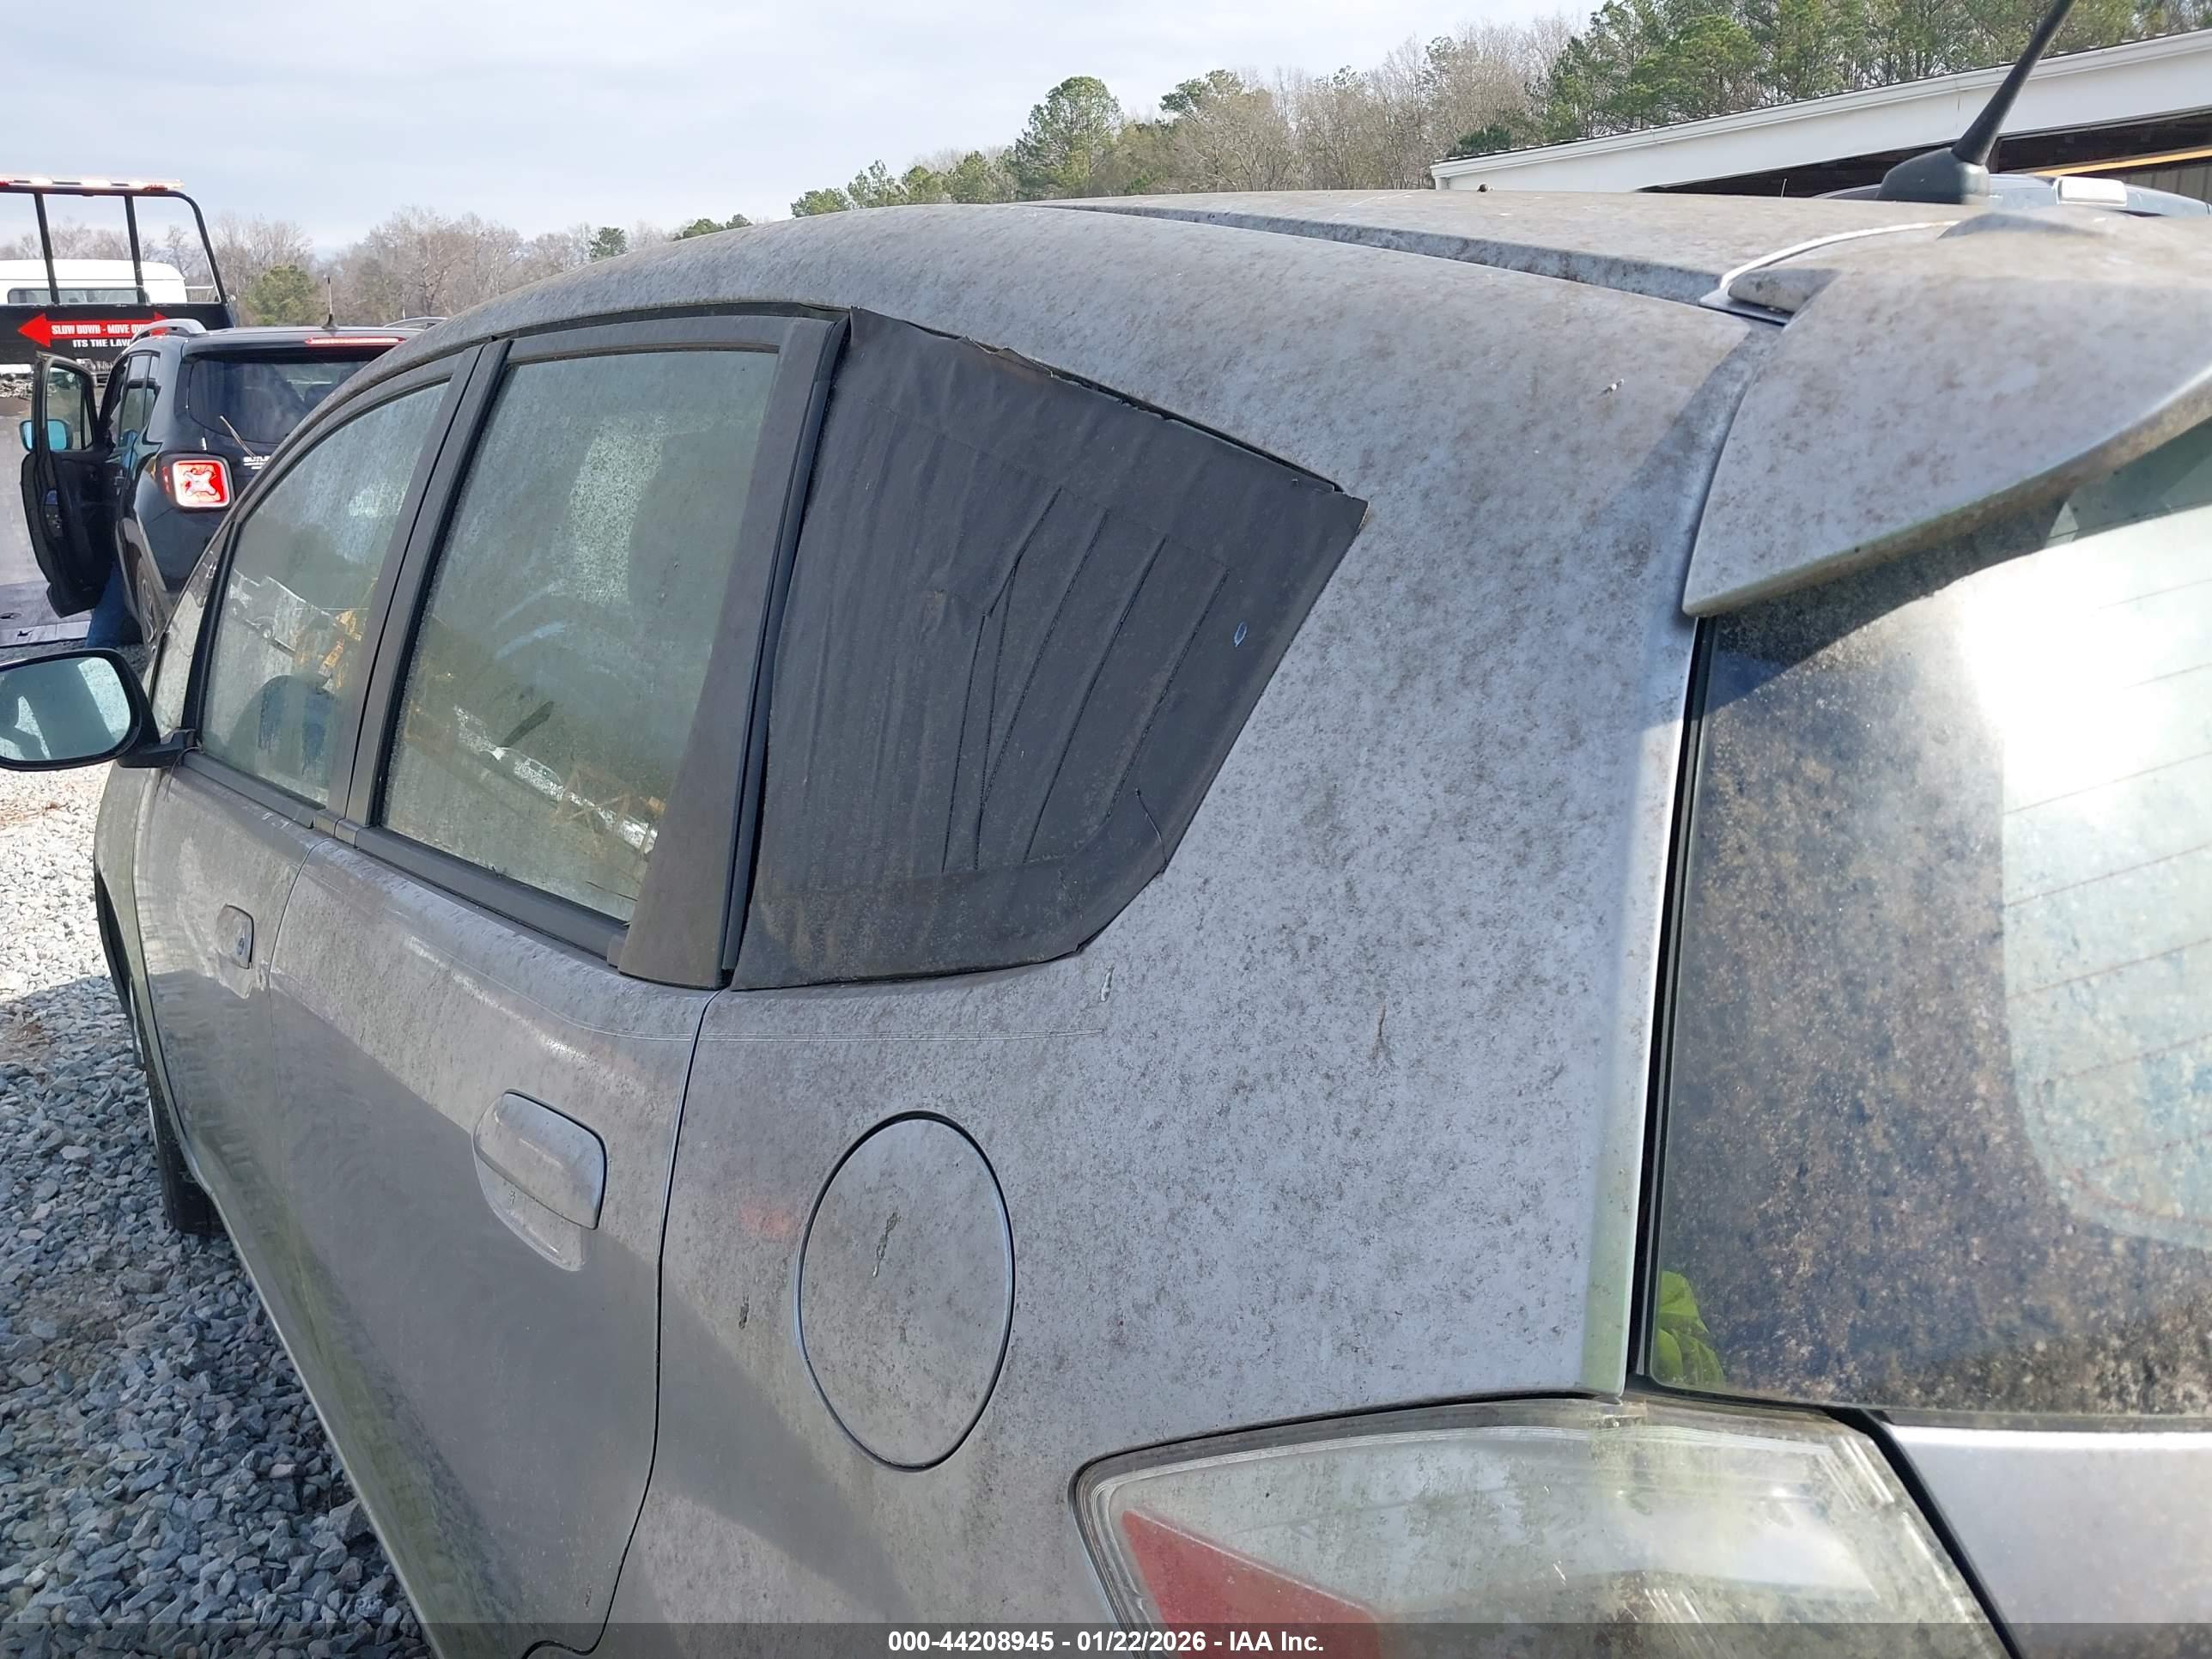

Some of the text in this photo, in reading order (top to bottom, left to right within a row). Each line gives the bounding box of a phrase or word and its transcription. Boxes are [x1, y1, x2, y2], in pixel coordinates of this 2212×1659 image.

[52, 325, 76, 335] SLOW
[76, 325, 101, 335] DOWN
[106, 324, 131, 334] MOVE
[131, 324, 144, 334] OV
[72, 338, 131, 348] ITS THE LAW
